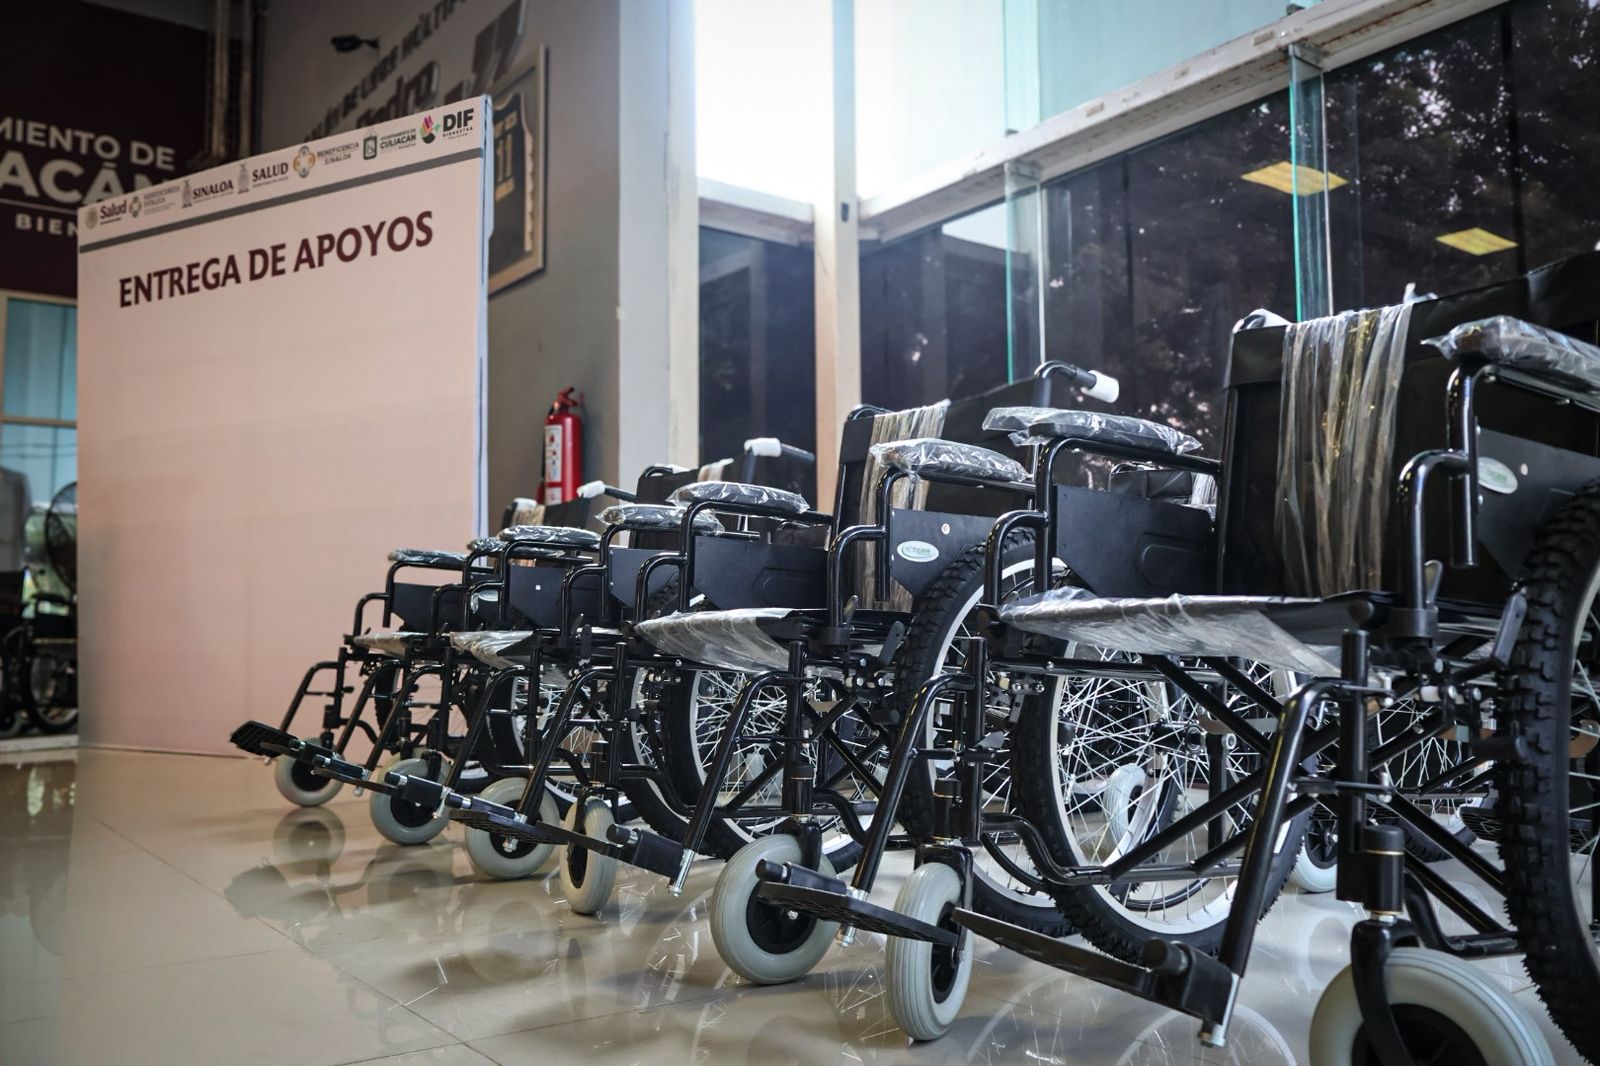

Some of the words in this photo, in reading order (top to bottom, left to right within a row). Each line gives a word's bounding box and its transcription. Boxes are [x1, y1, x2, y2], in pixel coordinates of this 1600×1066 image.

[443, 108, 475, 133] DIF
[130, 140, 175, 171] DE
[317, 142, 360, 157] BENEFICENCIA
[252, 162, 289, 182] SALUD
[192, 179, 234, 200] SINALOA
[100, 200, 127, 219] Salud
[119, 254, 241, 308] ENTREGA
[248, 243, 286, 281] DE
[293, 210, 433, 273] APOYOS
